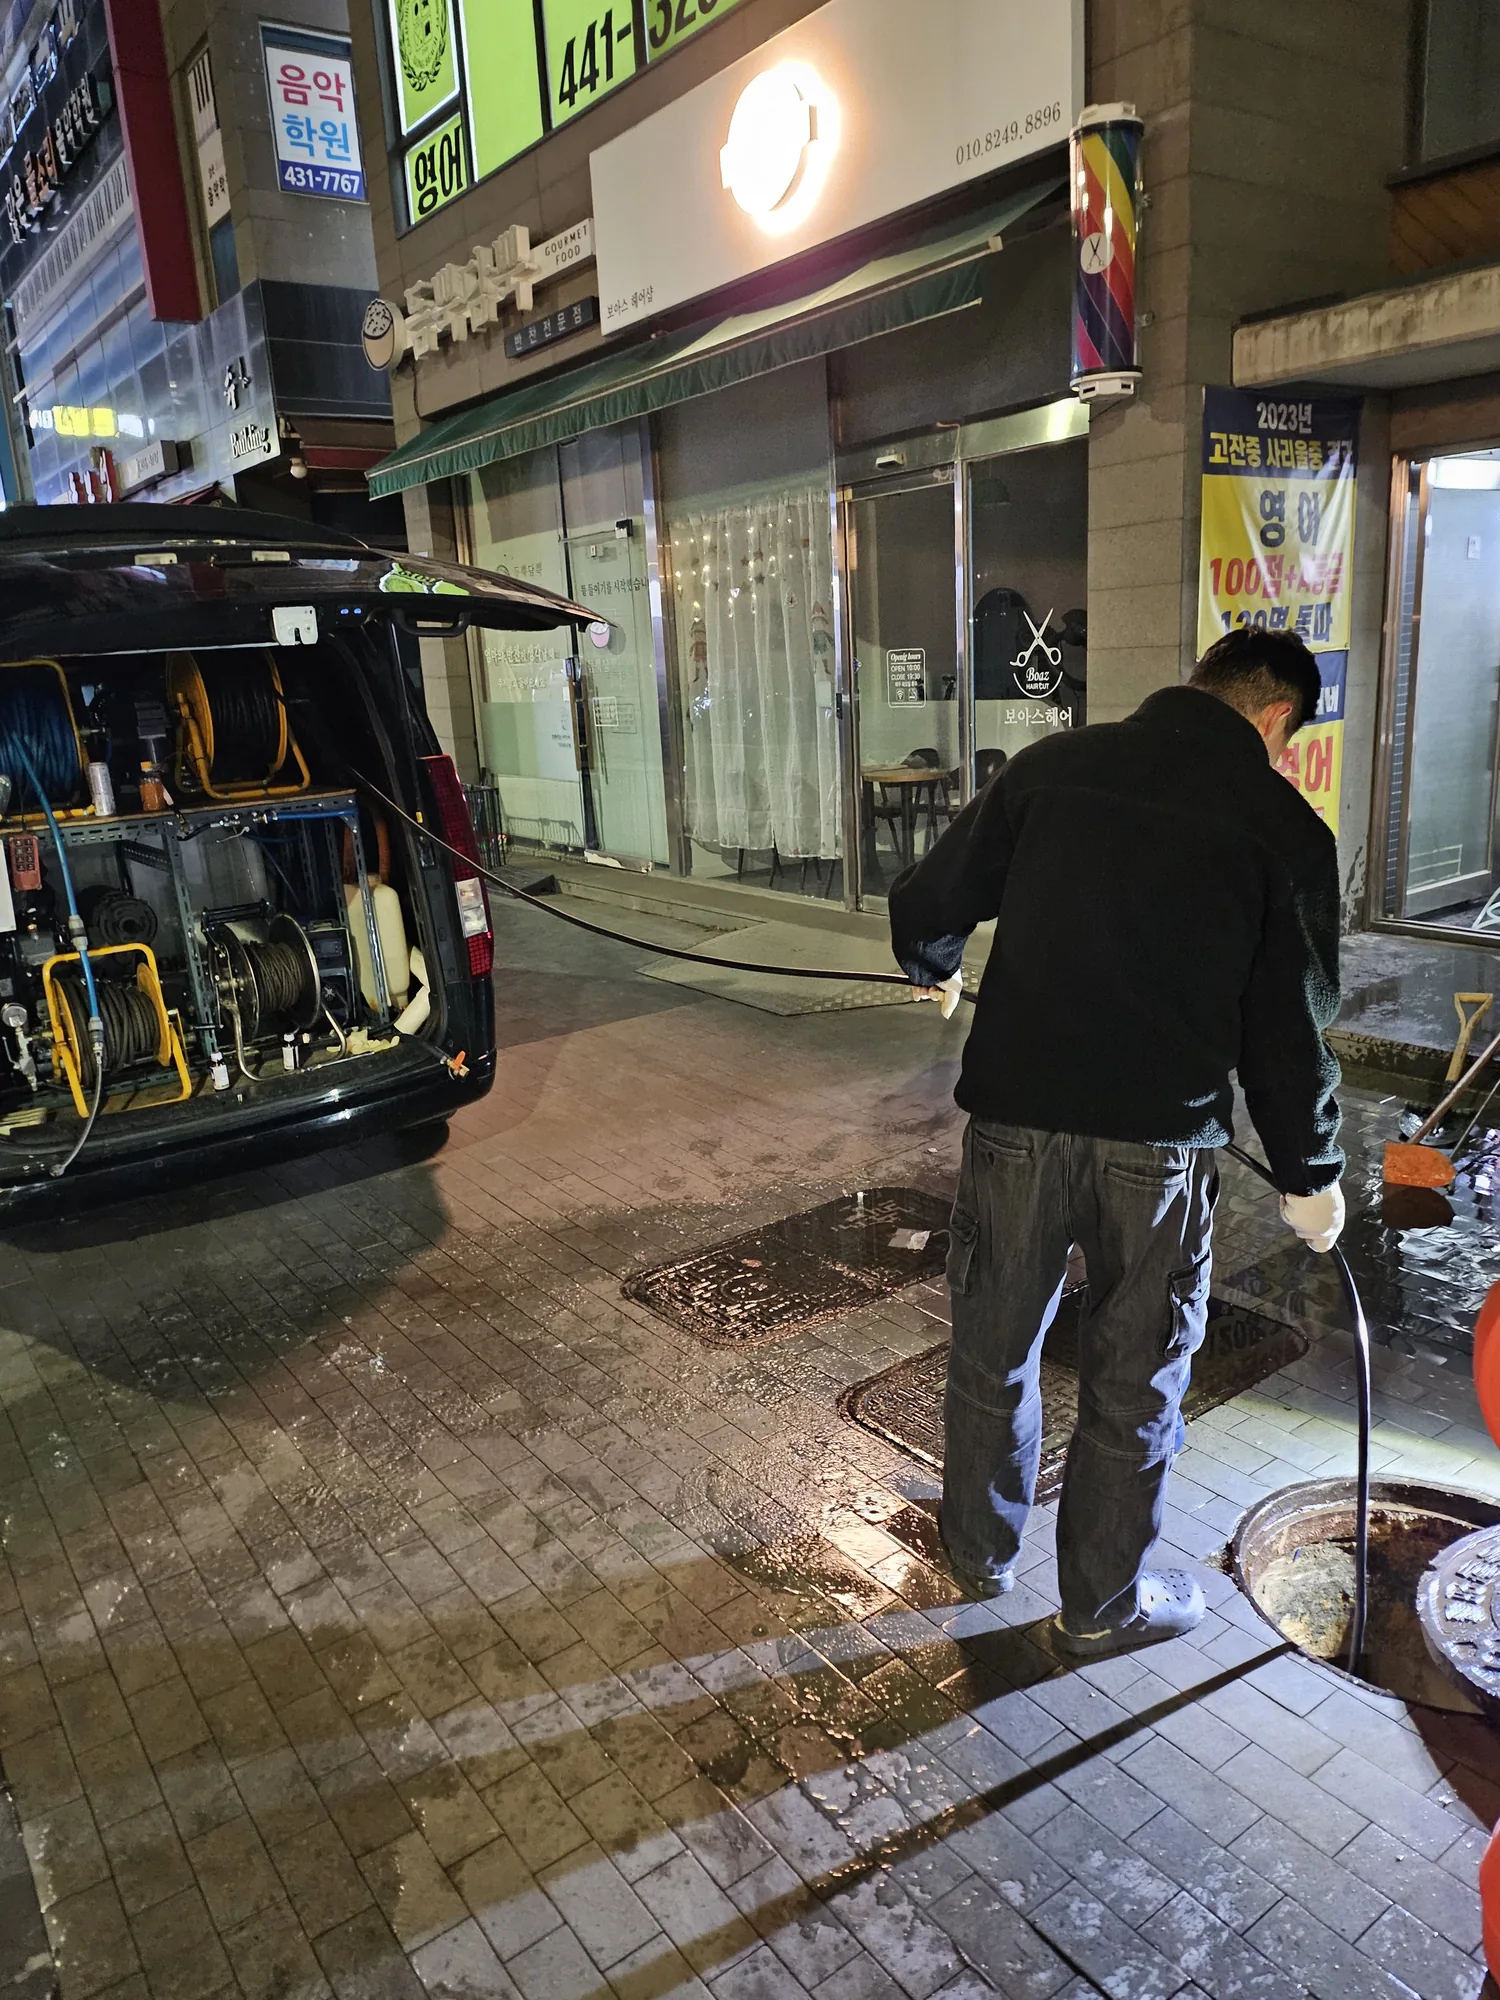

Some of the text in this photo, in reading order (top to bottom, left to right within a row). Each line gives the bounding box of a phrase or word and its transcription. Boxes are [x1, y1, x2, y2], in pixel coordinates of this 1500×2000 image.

[277, 63, 347, 113] 음악
[282, 114, 352, 162] 학원
[956, 101, 1062, 166] 010.8249.8896
[284, 165, 361, 195] 431-7767
[414, 126, 466, 216] 영어
[544, 225, 589, 257] GOURMET
[555, 244, 582, 266] FOOD
[607, 285, 654, 319] 보아스 헤어샵
[513, 303, 582, 350] 반찬전문점
[1256, 402, 1312, 434] 2023년
[230, 424, 271, 459] Building
[1208, 432, 1261, 468] 고잔중
[1266, 437, 1323, 471] 사리울중
[1297, 601, 1334, 644] 돌파
[1026, 667, 1050, 681] Boaz
[1004, 706, 1072, 728] 보아스헤어
